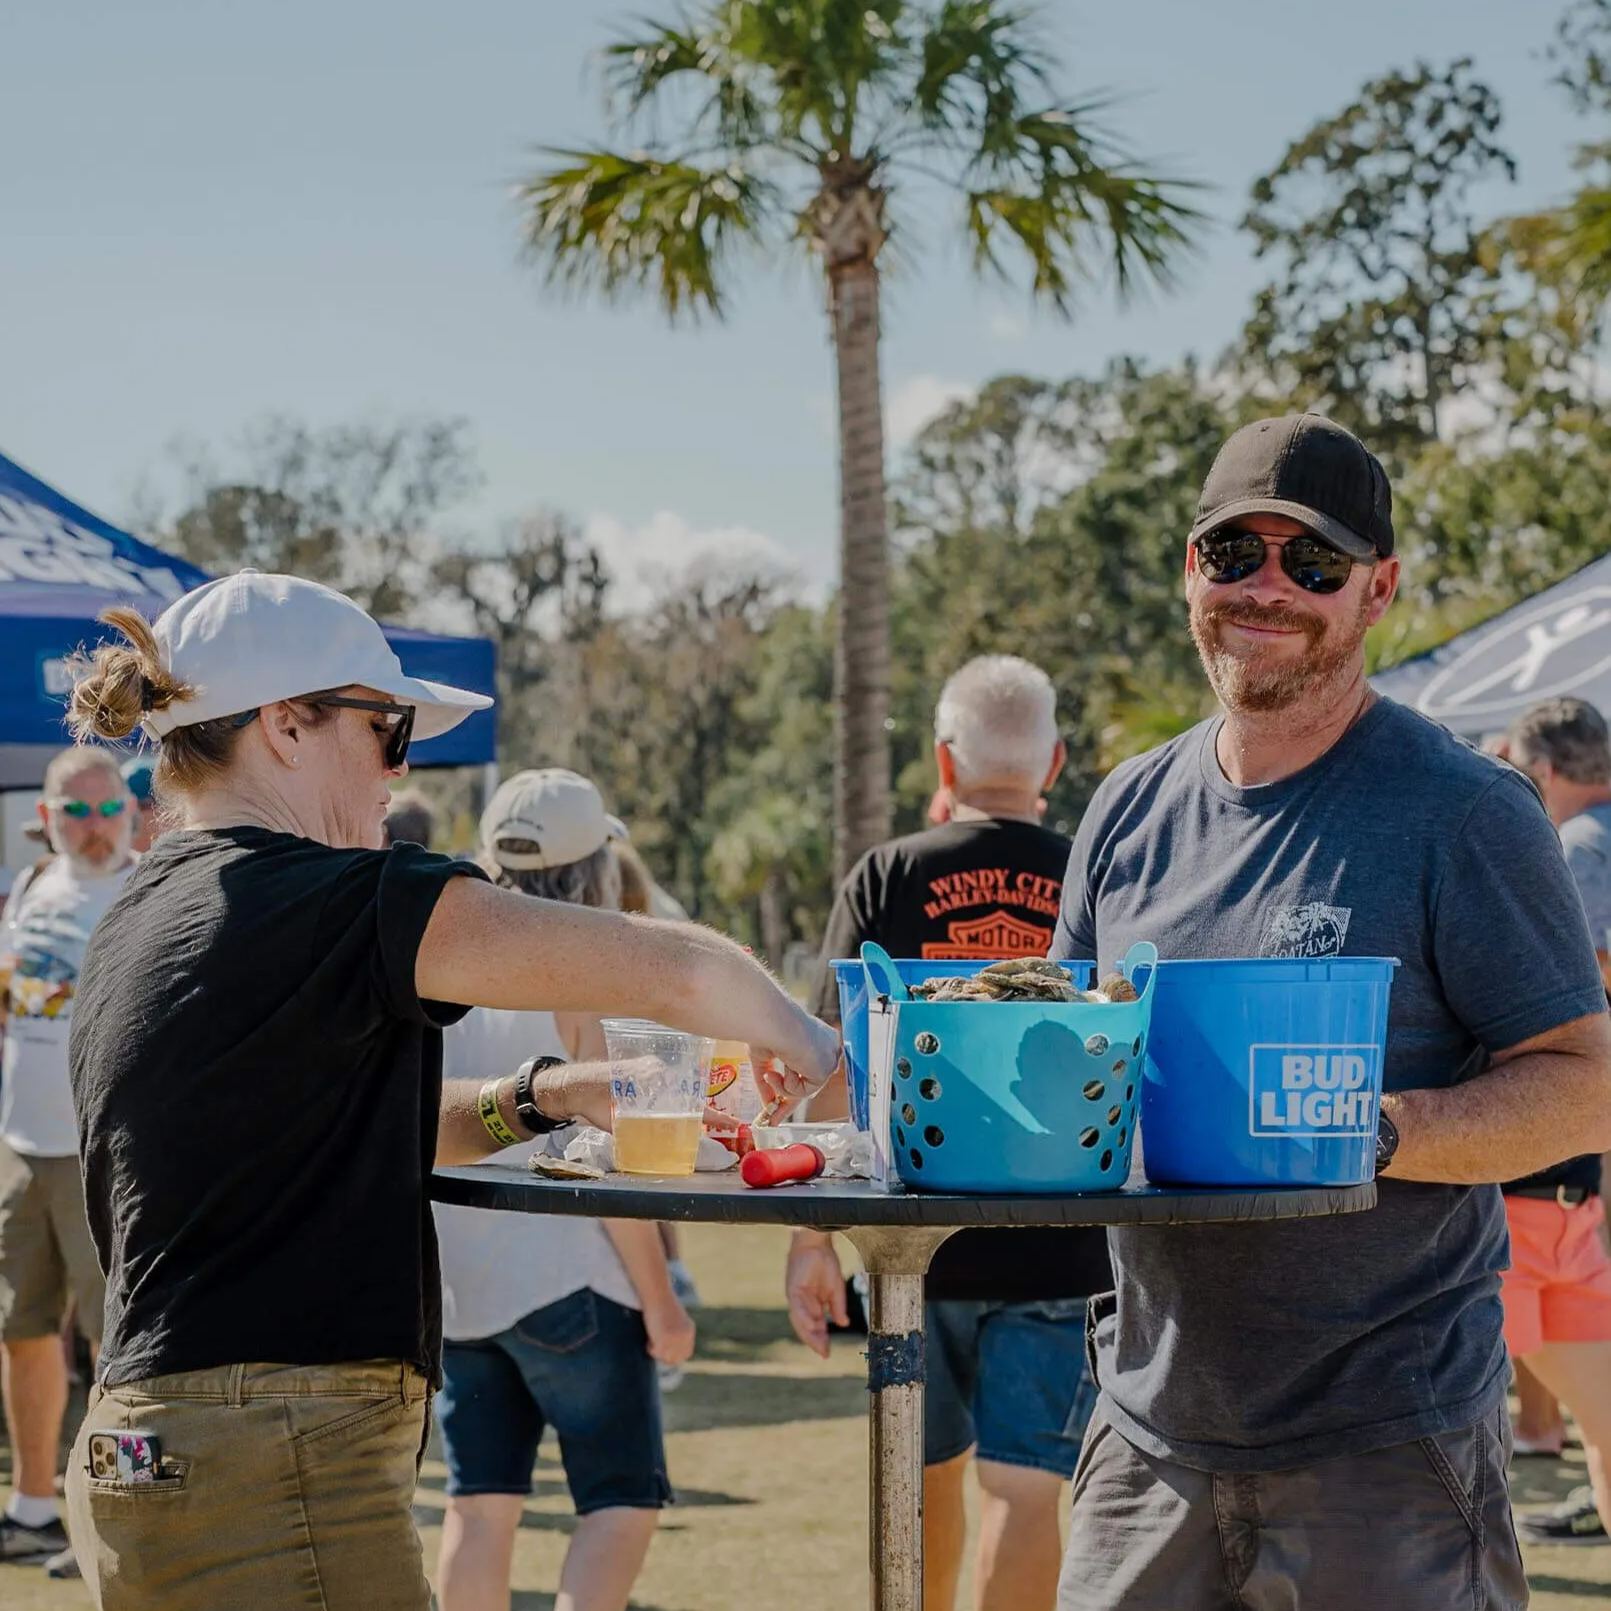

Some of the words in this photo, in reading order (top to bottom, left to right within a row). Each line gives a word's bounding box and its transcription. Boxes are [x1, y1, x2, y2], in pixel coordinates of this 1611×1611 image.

[928, 868, 1011, 897] WINDY
[1015, 872, 1062, 900] CIT
[967, 924, 1036, 949] MOTOR
[709, 1070, 729, 1085] ETE
[1282, 1055, 1366, 1090] BUD
[1261, 1091, 1374, 1127] LIGHT
